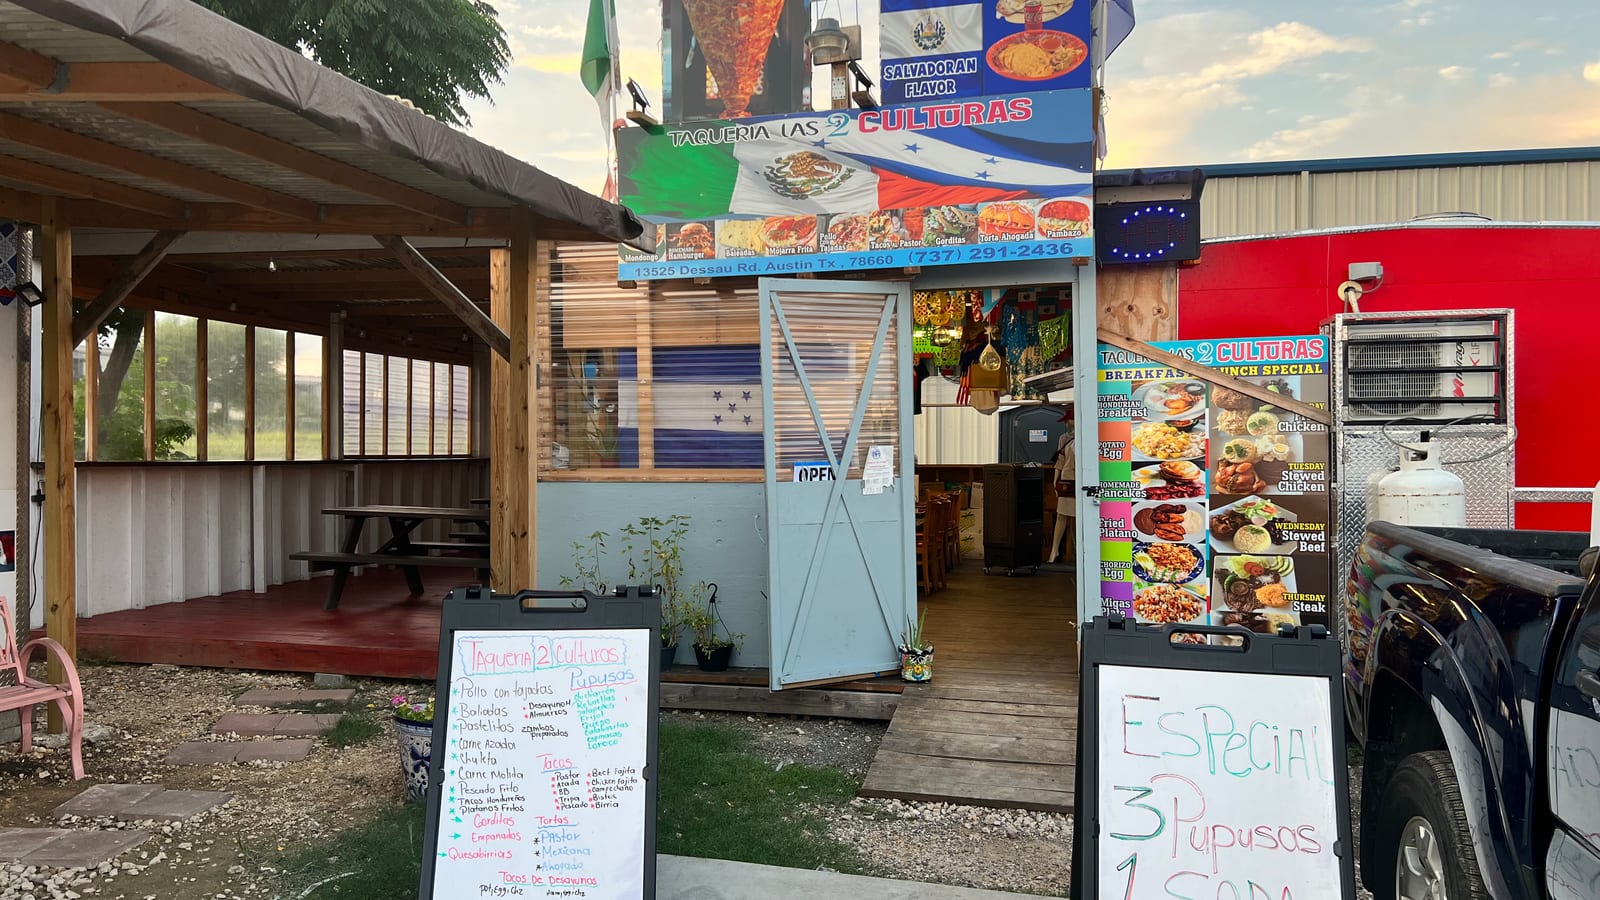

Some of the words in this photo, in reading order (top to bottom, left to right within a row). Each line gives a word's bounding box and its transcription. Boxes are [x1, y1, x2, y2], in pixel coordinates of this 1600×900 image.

[884, 57, 977, 81] SALVADORAN
[905, 80, 956, 98] FLAVOR
[668, 125, 770, 147] TAQUERIA
[782, 121, 819, 137] LAS
[826, 113, 850, 137] 2
[858, 98, 1032, 133] CULTURAS
[980, 234, 998, 242] Torta
[1001, 232, 1034, 242] Ahogada
[1047, 230, 1082, 238] Pambazo
[871, 241, 891, 249] Tacos
[899, 240, 921, 248] Pastor
[936, 237, 966, 245] Gorditas
[769, 247, 796, 256] Mojarra
[797, 245, 814, 254] Frita
[625, 254, 659, 262] Mondongo
[635, 266, 675, 277] 13525
[680, 265, 732, 275] Dessau
[737, 263, 760, 272] Rd.
[765, 260, 812, 271] Austin
[850, 255, 894, 267] 78660
[909, 248, 962, 263] (737)
[969, 242, 1074, 259] 291-2436
[1197, 343, 1213, 364] 2
[1217, 339, 1324, 361] CULTURAS
[1105, 369, 1194, 381] BREAKFAS
[1263, 364, 1323, 375] SPECIAL
[1098, 408, 1147, 417] Breakfast
[1278, 421, 1325, 432] Chicken
[1282, 470, 1325, 480] Stewed
[1278, 481, 1325, 491] Chicken
[1099, 488, 1147, 498] Pancakes
[1100, 518, 1125, 528] Fried
[1275, 522, 1325, 531] WEDNESDAY
[1100, 528, 1138, 538] Platano
[1282, 531, 1325, 541] Stewed
[1300, 541, 1325, 552] Beef
[1283, 593, 1326, 601] THURSDAY
[1101, 597, 1130, 609] Migas
[1294, 602, 1326, 612] Steak
[537, 646, 550, 665] 2
[556, 640, 619, 663] Culturas
[564, 666, 635, 692] Pupusas
[456, 677, 487, 698] Pollo
[494, 687, 510, 698] con
[456, 718, 514, 735] Pastelitos
[458, 766, 487, 780] Carne
[490, 767, 524, 779] Molida
[555, 770, 580, 781] Pastor
[458, 781, 496, 796] Pescado
[499, 781, 519, 793] Frito
[534, 814, 569, 825] Tortas
[1109, 785, 1165, 841] 3
[1150, 773, 1322, 874] Pupusas
[472, 828, 522, 845] Empanadas
[448, 847, 513, 860] Quesabirrias
[542, 845, 591, 859] Mexicana
[498, 871, 527, 883] Tacos
